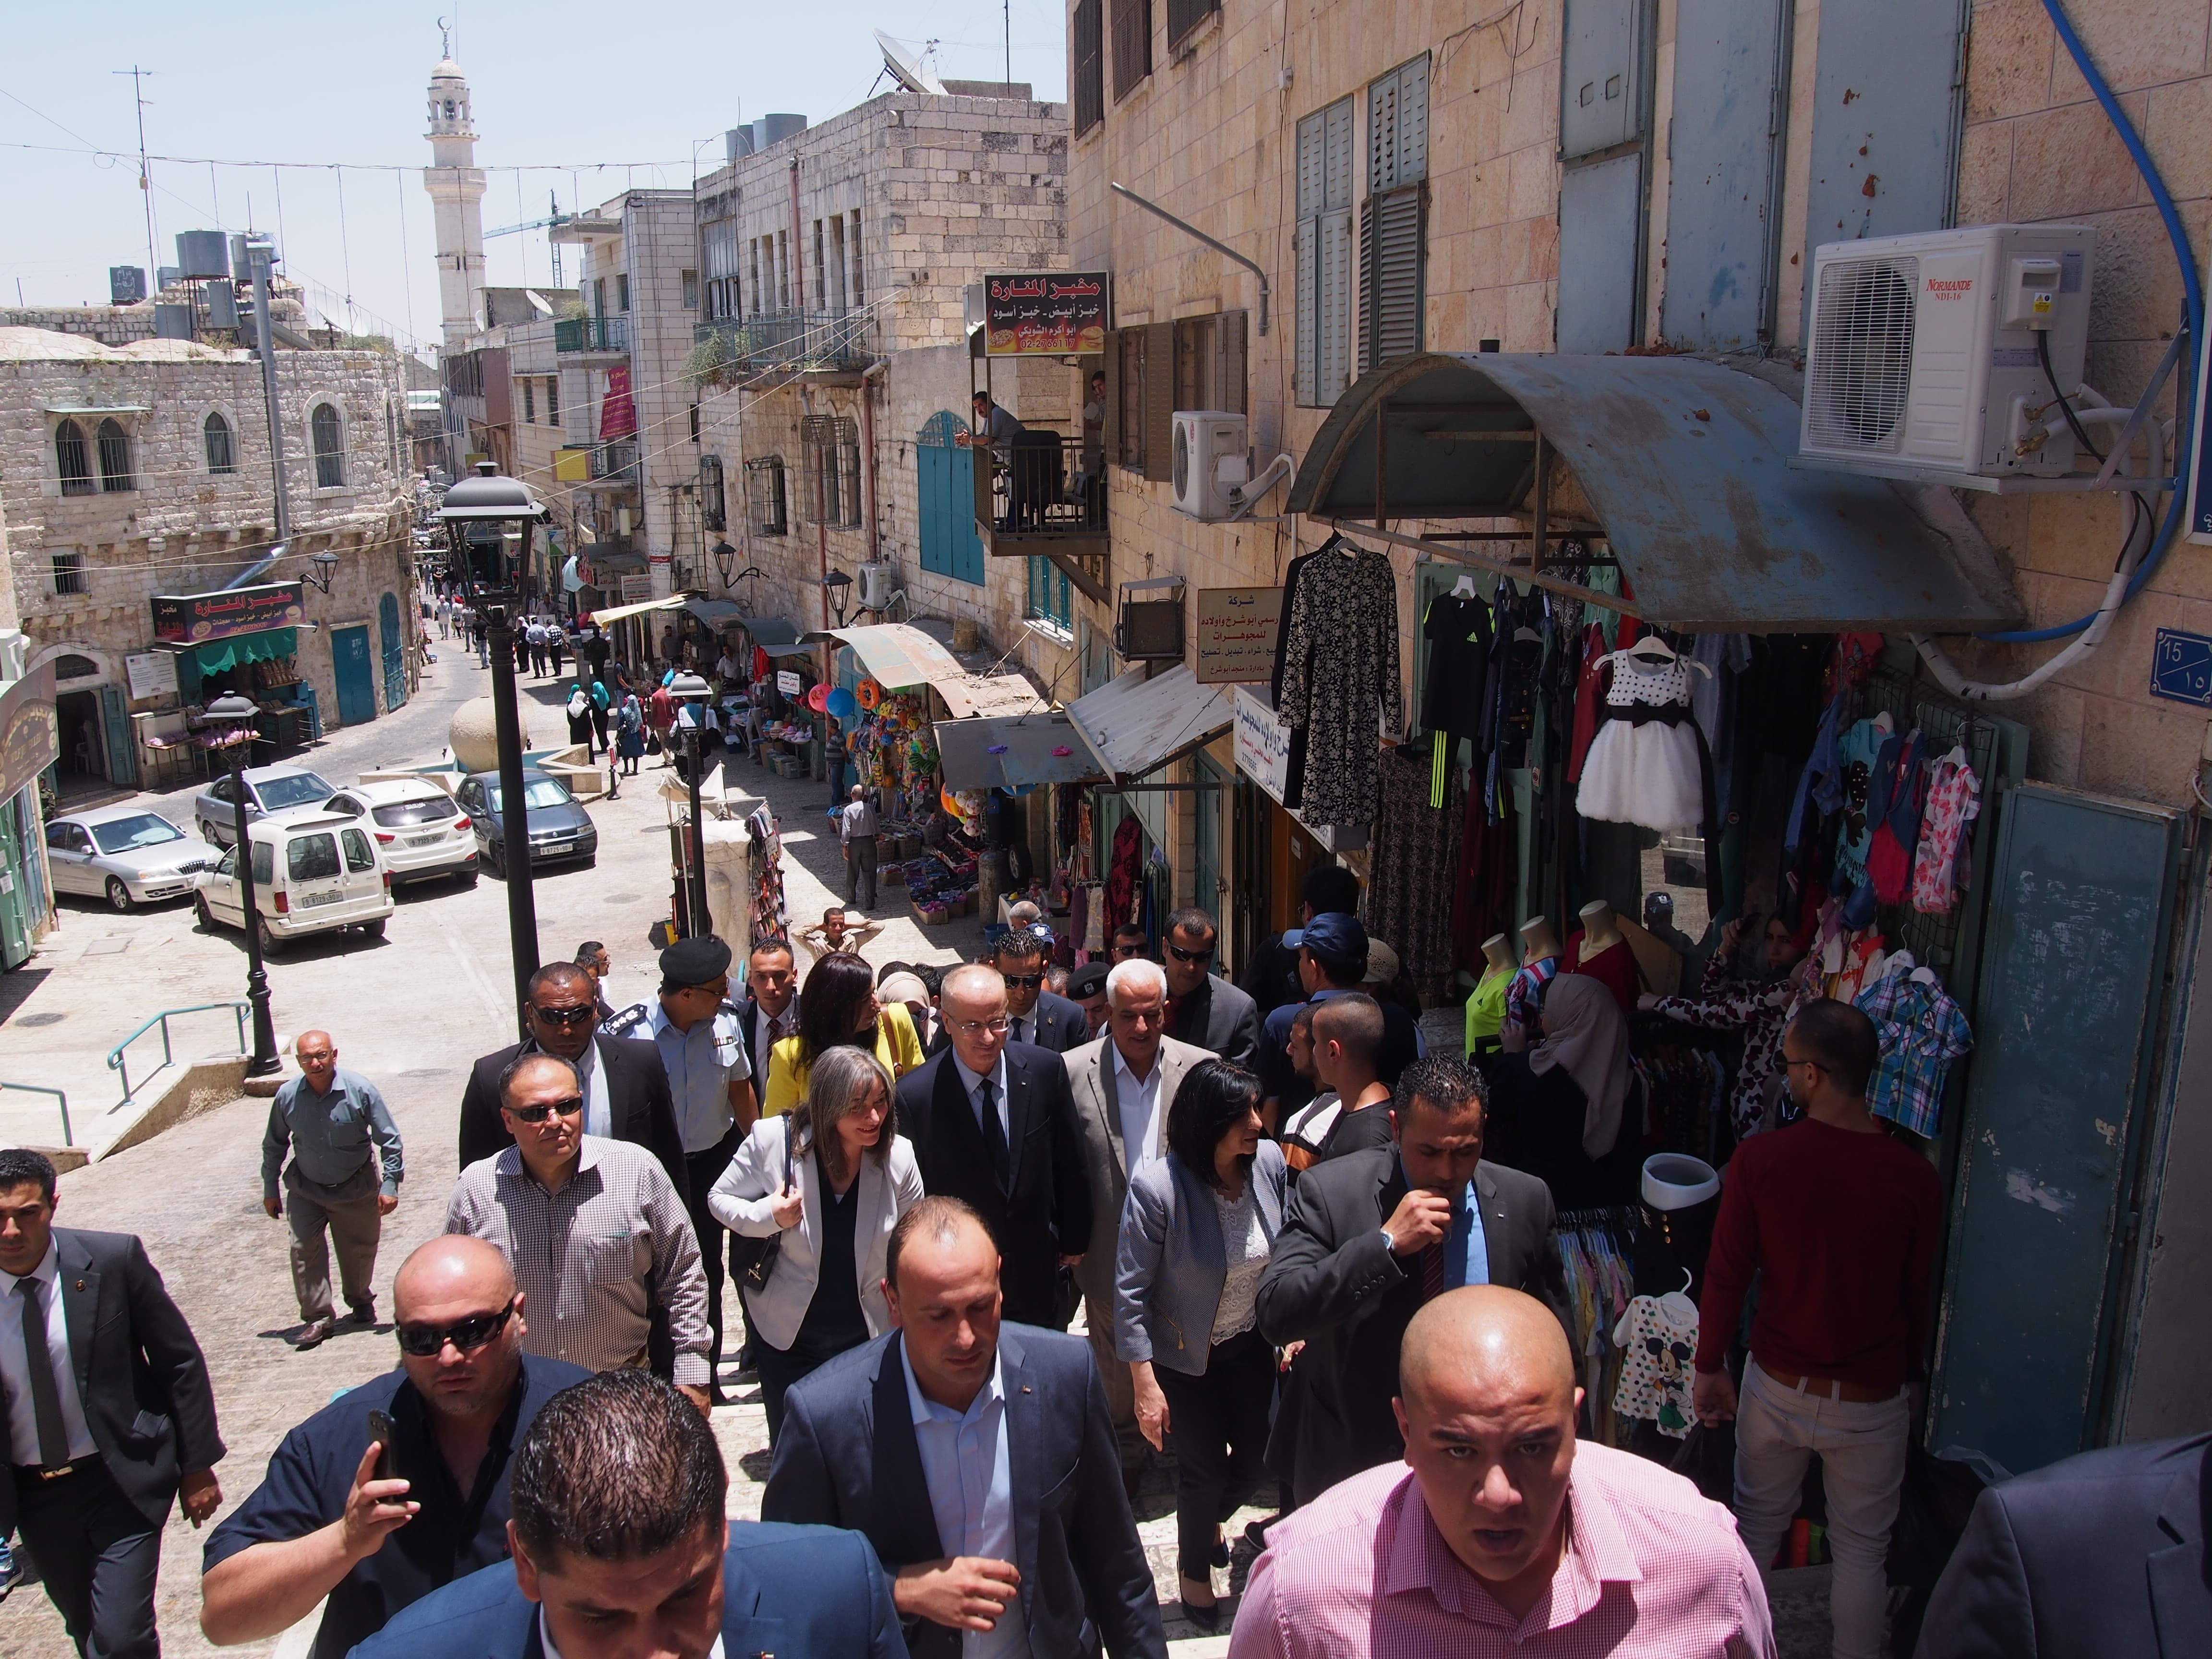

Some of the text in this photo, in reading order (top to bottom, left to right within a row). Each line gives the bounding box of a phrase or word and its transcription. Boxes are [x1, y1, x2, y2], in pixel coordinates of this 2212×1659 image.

[991, 277, 1101, 301] مخبز المنارة
[1926, 278, 1972, 291] NORMANDE
[1935, 292, 1961, 301] NDI-16
[993, 303, 1100, 320] خبز أبيض خبز أسود
[1018, 324, 1076, 338] أبو أكرم الشويكي
[1021, 338, 1075, 349] 02-2766117
[195, 589, 293, 617] مخبز المنارة
[1228, 595, 1254, 607] شركة
[160, 604, 177, 615] مخبز
[1201, 615, 1225, 627] وأولاده
[1258, 616, 1278, 627] رسمي
[1213, 631, 1266, 642] للمجوهرات
[1201, 648, 1220, 658] تصليح
[1225, 647, 1243, 657] تبديل
[1248, 646, 1261, 655] شراء
[2164, 640, 2182, 662] 15
[2186, 672, 2204, 690] ١٥
